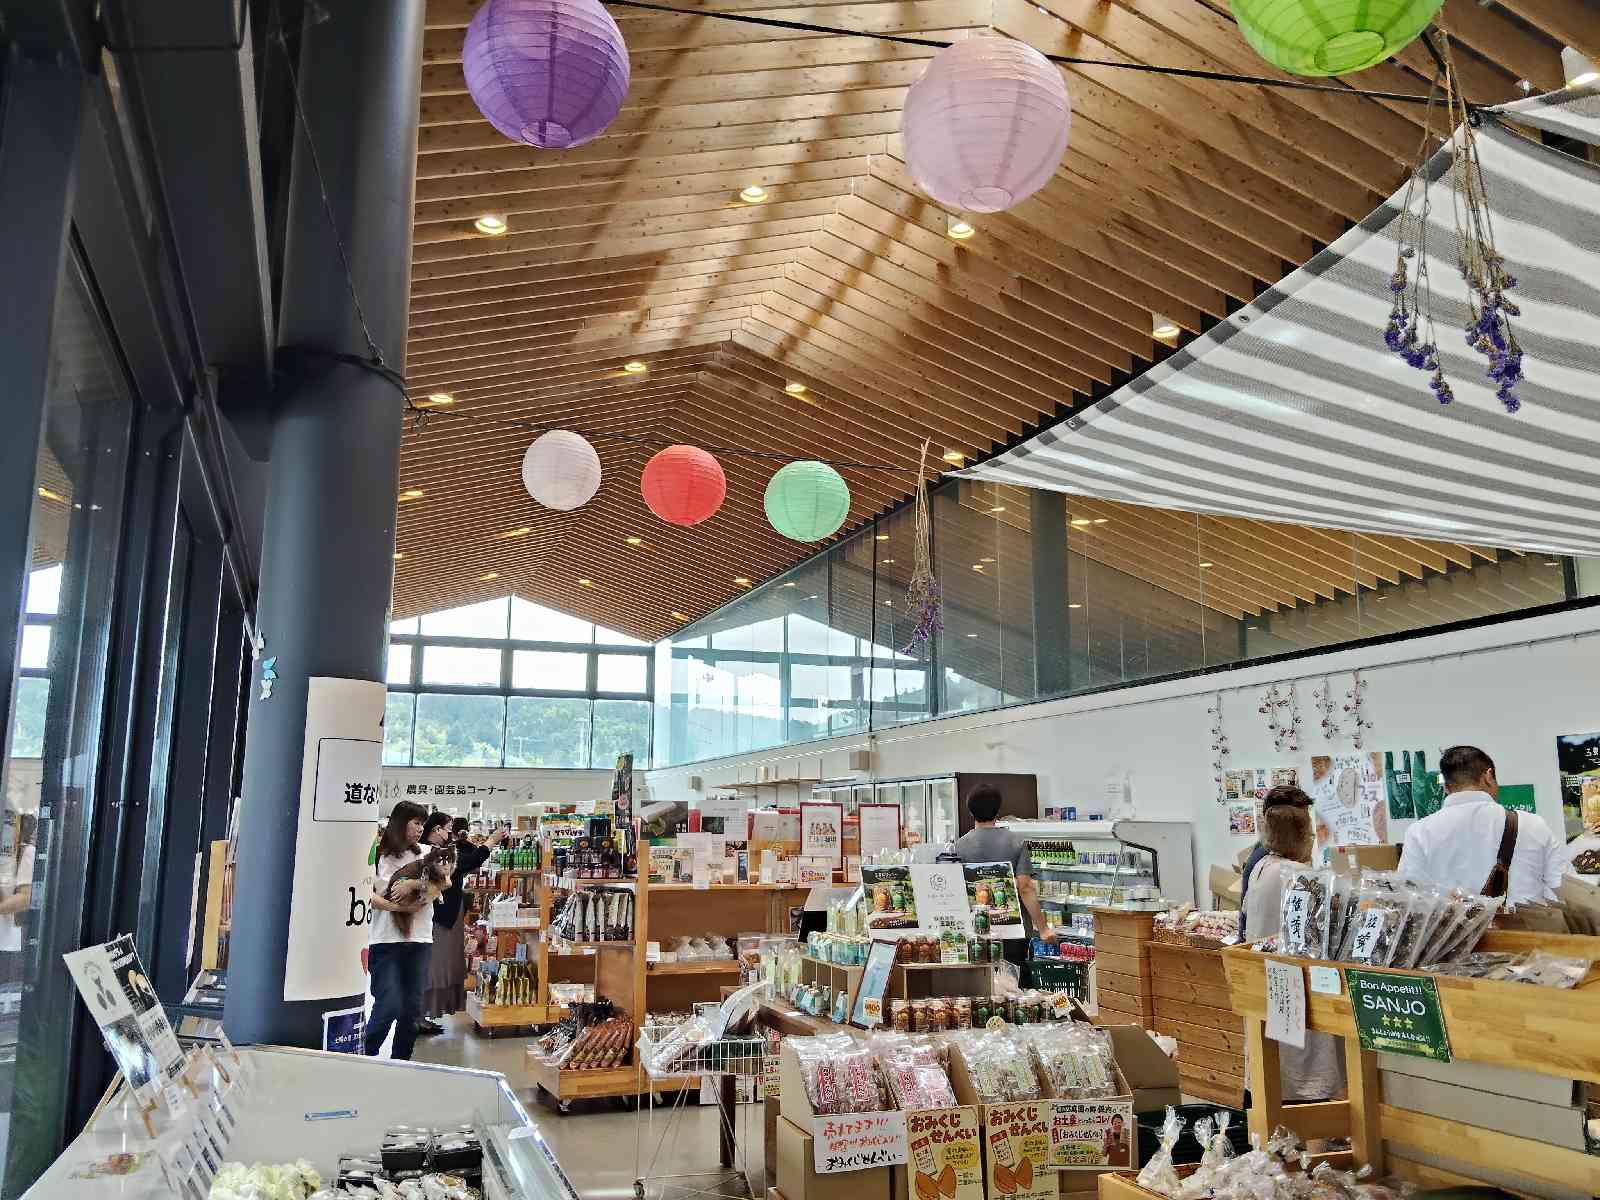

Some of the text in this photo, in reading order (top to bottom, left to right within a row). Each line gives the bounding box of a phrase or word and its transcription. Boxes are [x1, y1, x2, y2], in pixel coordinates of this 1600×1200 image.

[405, 783, 508, 796] 農具・園芸品コーナー
[1360, 979, 1423, 995] Bon Appetit!!
[1362, 994, 1426, 1016] SANJO
[911, 1113, 961, 1133] おみくじ
[990, 1106, 1038, 1127] おみくじ
[929, 1128, 977, 1143] せんべい
